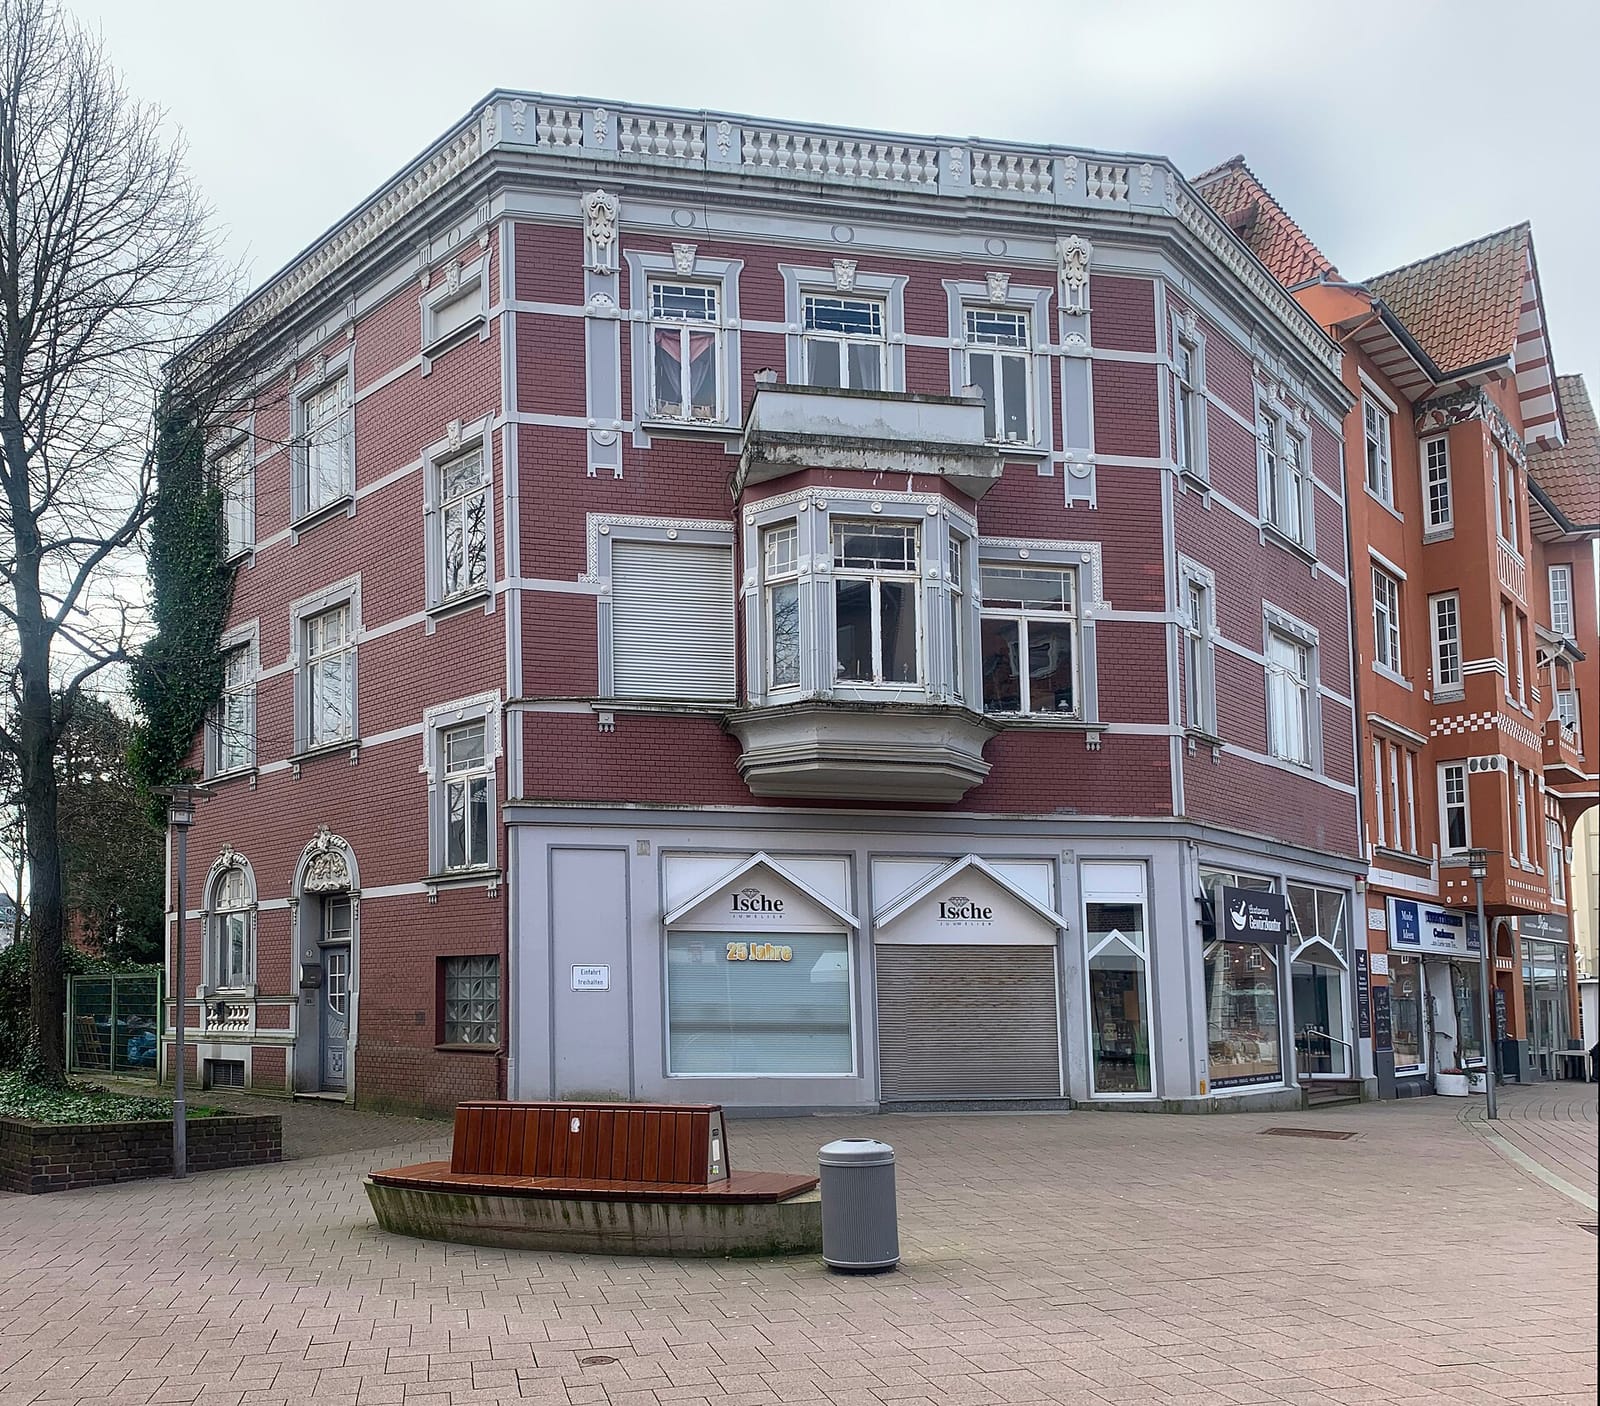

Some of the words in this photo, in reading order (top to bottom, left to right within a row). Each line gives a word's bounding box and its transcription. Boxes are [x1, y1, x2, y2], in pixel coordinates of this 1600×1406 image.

[731, 893, 784, 912] Ische
[727, 942, 748, 961] 25
[749, 942, 793, 962] Jahre
